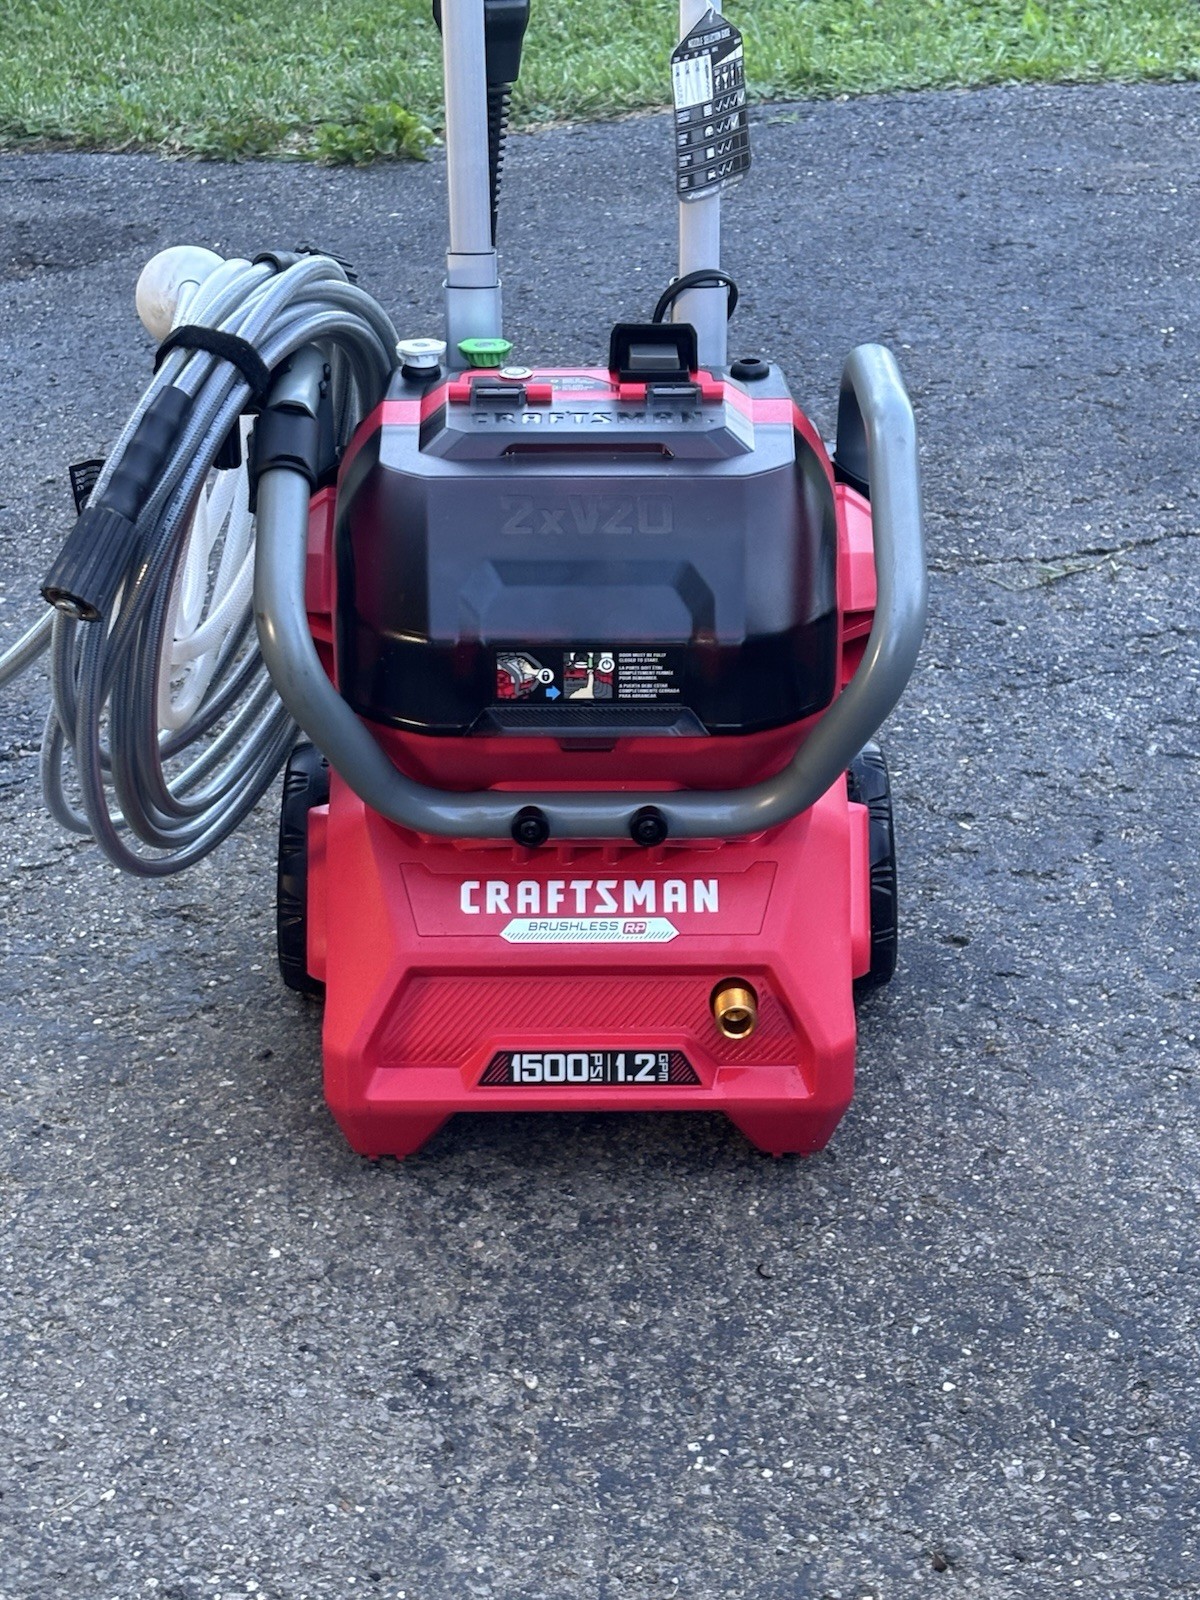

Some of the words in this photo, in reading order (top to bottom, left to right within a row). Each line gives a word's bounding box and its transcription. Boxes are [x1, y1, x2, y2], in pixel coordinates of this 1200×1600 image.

[471, 411, 703, 424] CRAFTSMAN
[501, 494, 674, 534] 2xV20
[460, 879, 719, 914] CRAFTSMAN
[528, 921, 619, 932] BRUSHLESS
[511, 1053, 589, 1083] 1500
[590, 1053, 603, 1082] PSI
[615, 1053, 656, 1082] 1.2
[658, 1053, 669, 1082] GPM
